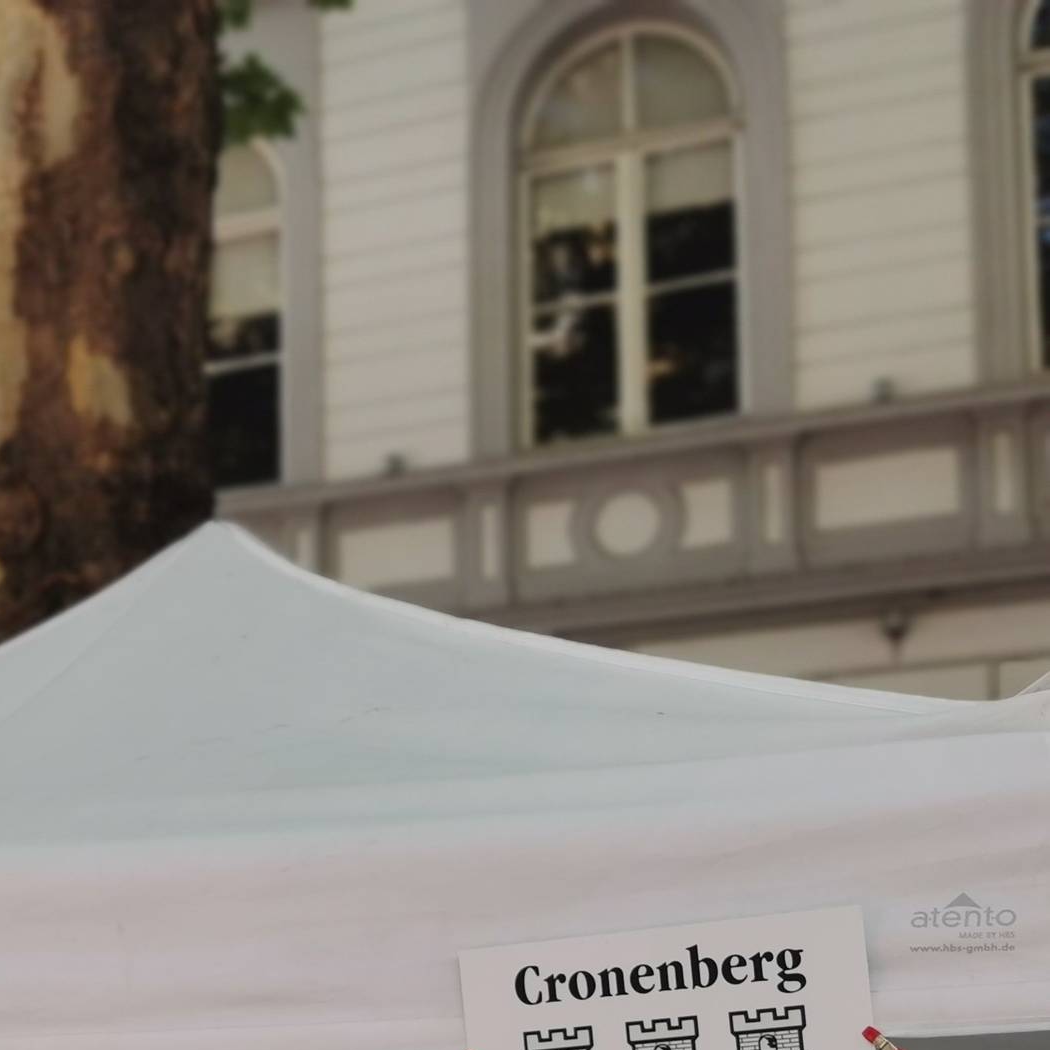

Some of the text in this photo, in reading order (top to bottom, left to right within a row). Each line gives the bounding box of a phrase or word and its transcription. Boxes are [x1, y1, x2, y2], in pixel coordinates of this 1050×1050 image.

[910, 906, 1017, 928] atento
[910, 943, 1015, 953] www.hbs-gmbh.de
[514, 944, 807, 1006] Cronenberg
